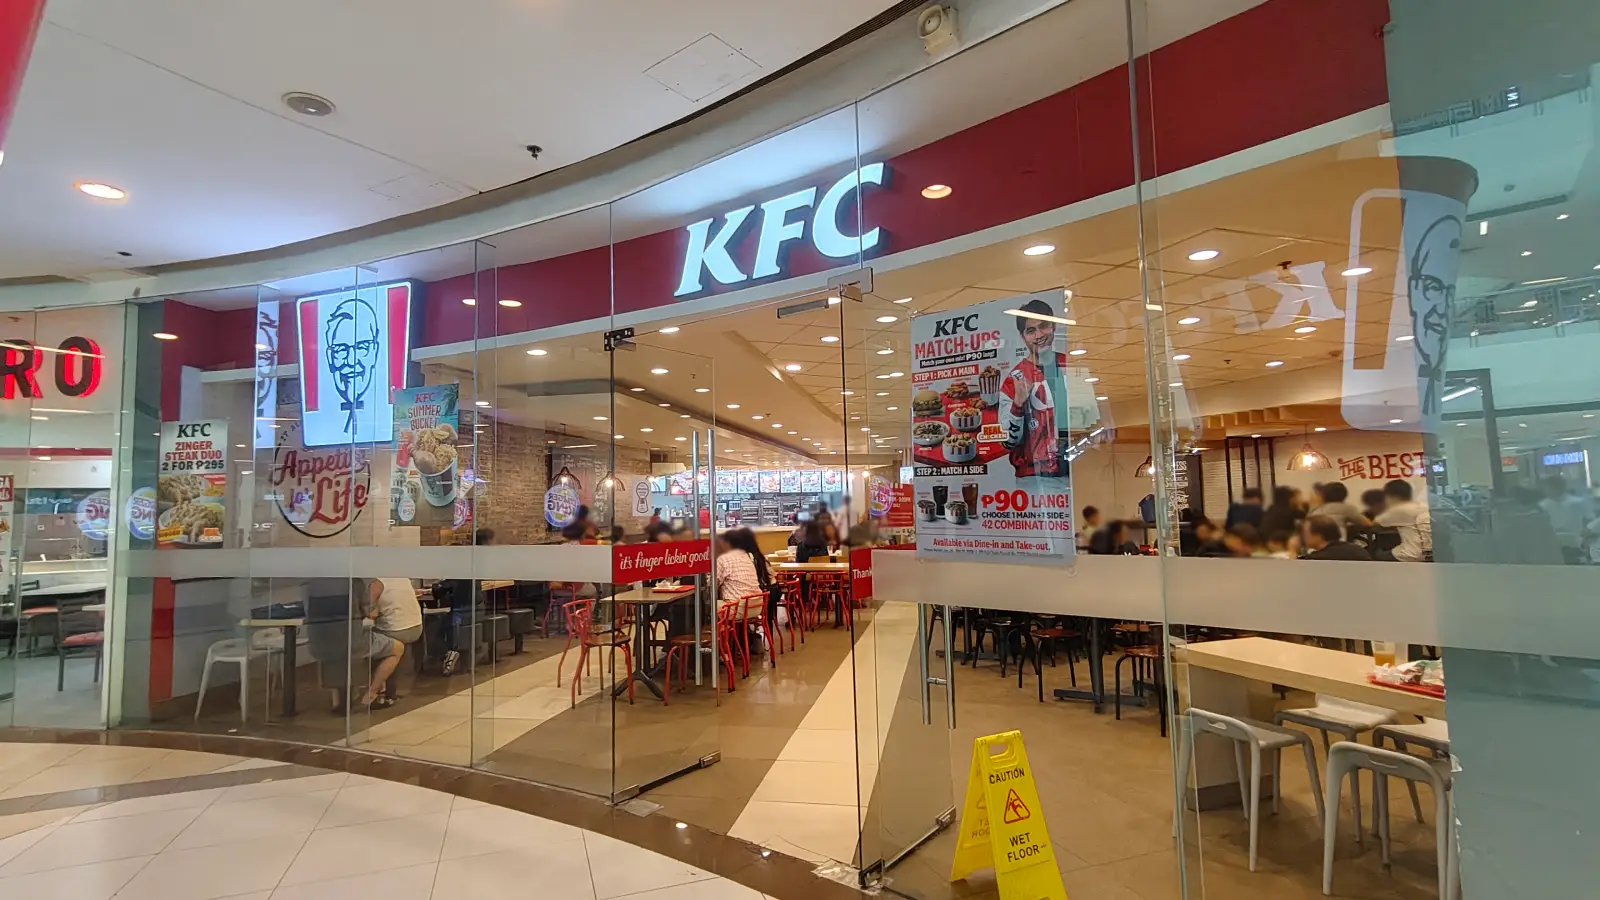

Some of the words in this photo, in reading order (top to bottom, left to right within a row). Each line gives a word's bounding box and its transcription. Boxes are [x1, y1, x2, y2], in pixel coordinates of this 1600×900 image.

[673, 162, 885, 298] KFC
[933, 313, 979, 338] KFC
[914, 330, 1000, 360] MATCH-UPS
[914, 372, 931, 381] STEP
[937, 368, 952, 378] PICK
[953, 367, 958, 376] A
[958, 365, 975, 375] MAIN
[415, 393, 436, 403] KFC
[408, 404, 442, 419] SUMMER
[177, 423, 212, 438] KFC
[410, 417, 438, 431] BUCKET
[175, 440, 213, 451] ZINGER
[165, 451, 199, 461] STEAK
[201, 449, 222, 460] DUO
[162, 462, 169, 471] 2
[172, 461, 194, 470] FOR
[916, 467, 932, 476] STEP
[941, 466, 963, 475] MATCH
[963, 466, 969, 474] A
[969, 465, 984, 474] SIDE
[1338, 459, 1365, 477] THE
[1366, 451, 1426, 479] BEST
[308, 476, 368, 524] Life
[1031, 494, 1069, 509] LANG!
[981, 520, 993, 530] 42
[994, 519, 1069, 531] COMBINATIONS
[933, 538, 963, 547] Available
[974, 540, 1000, 549] Dine-in
[1000, 541, 1014, 549] and
[635, 551, 664, 572] finger
[664, 548, 689, 565] lickin'
[688, 546, 710, 568] good
[989, 767, 1025, 785] CAUTION
[1009, 832, 1031, 847] WET
[1007, 844, 1041, 863] FLOOR
